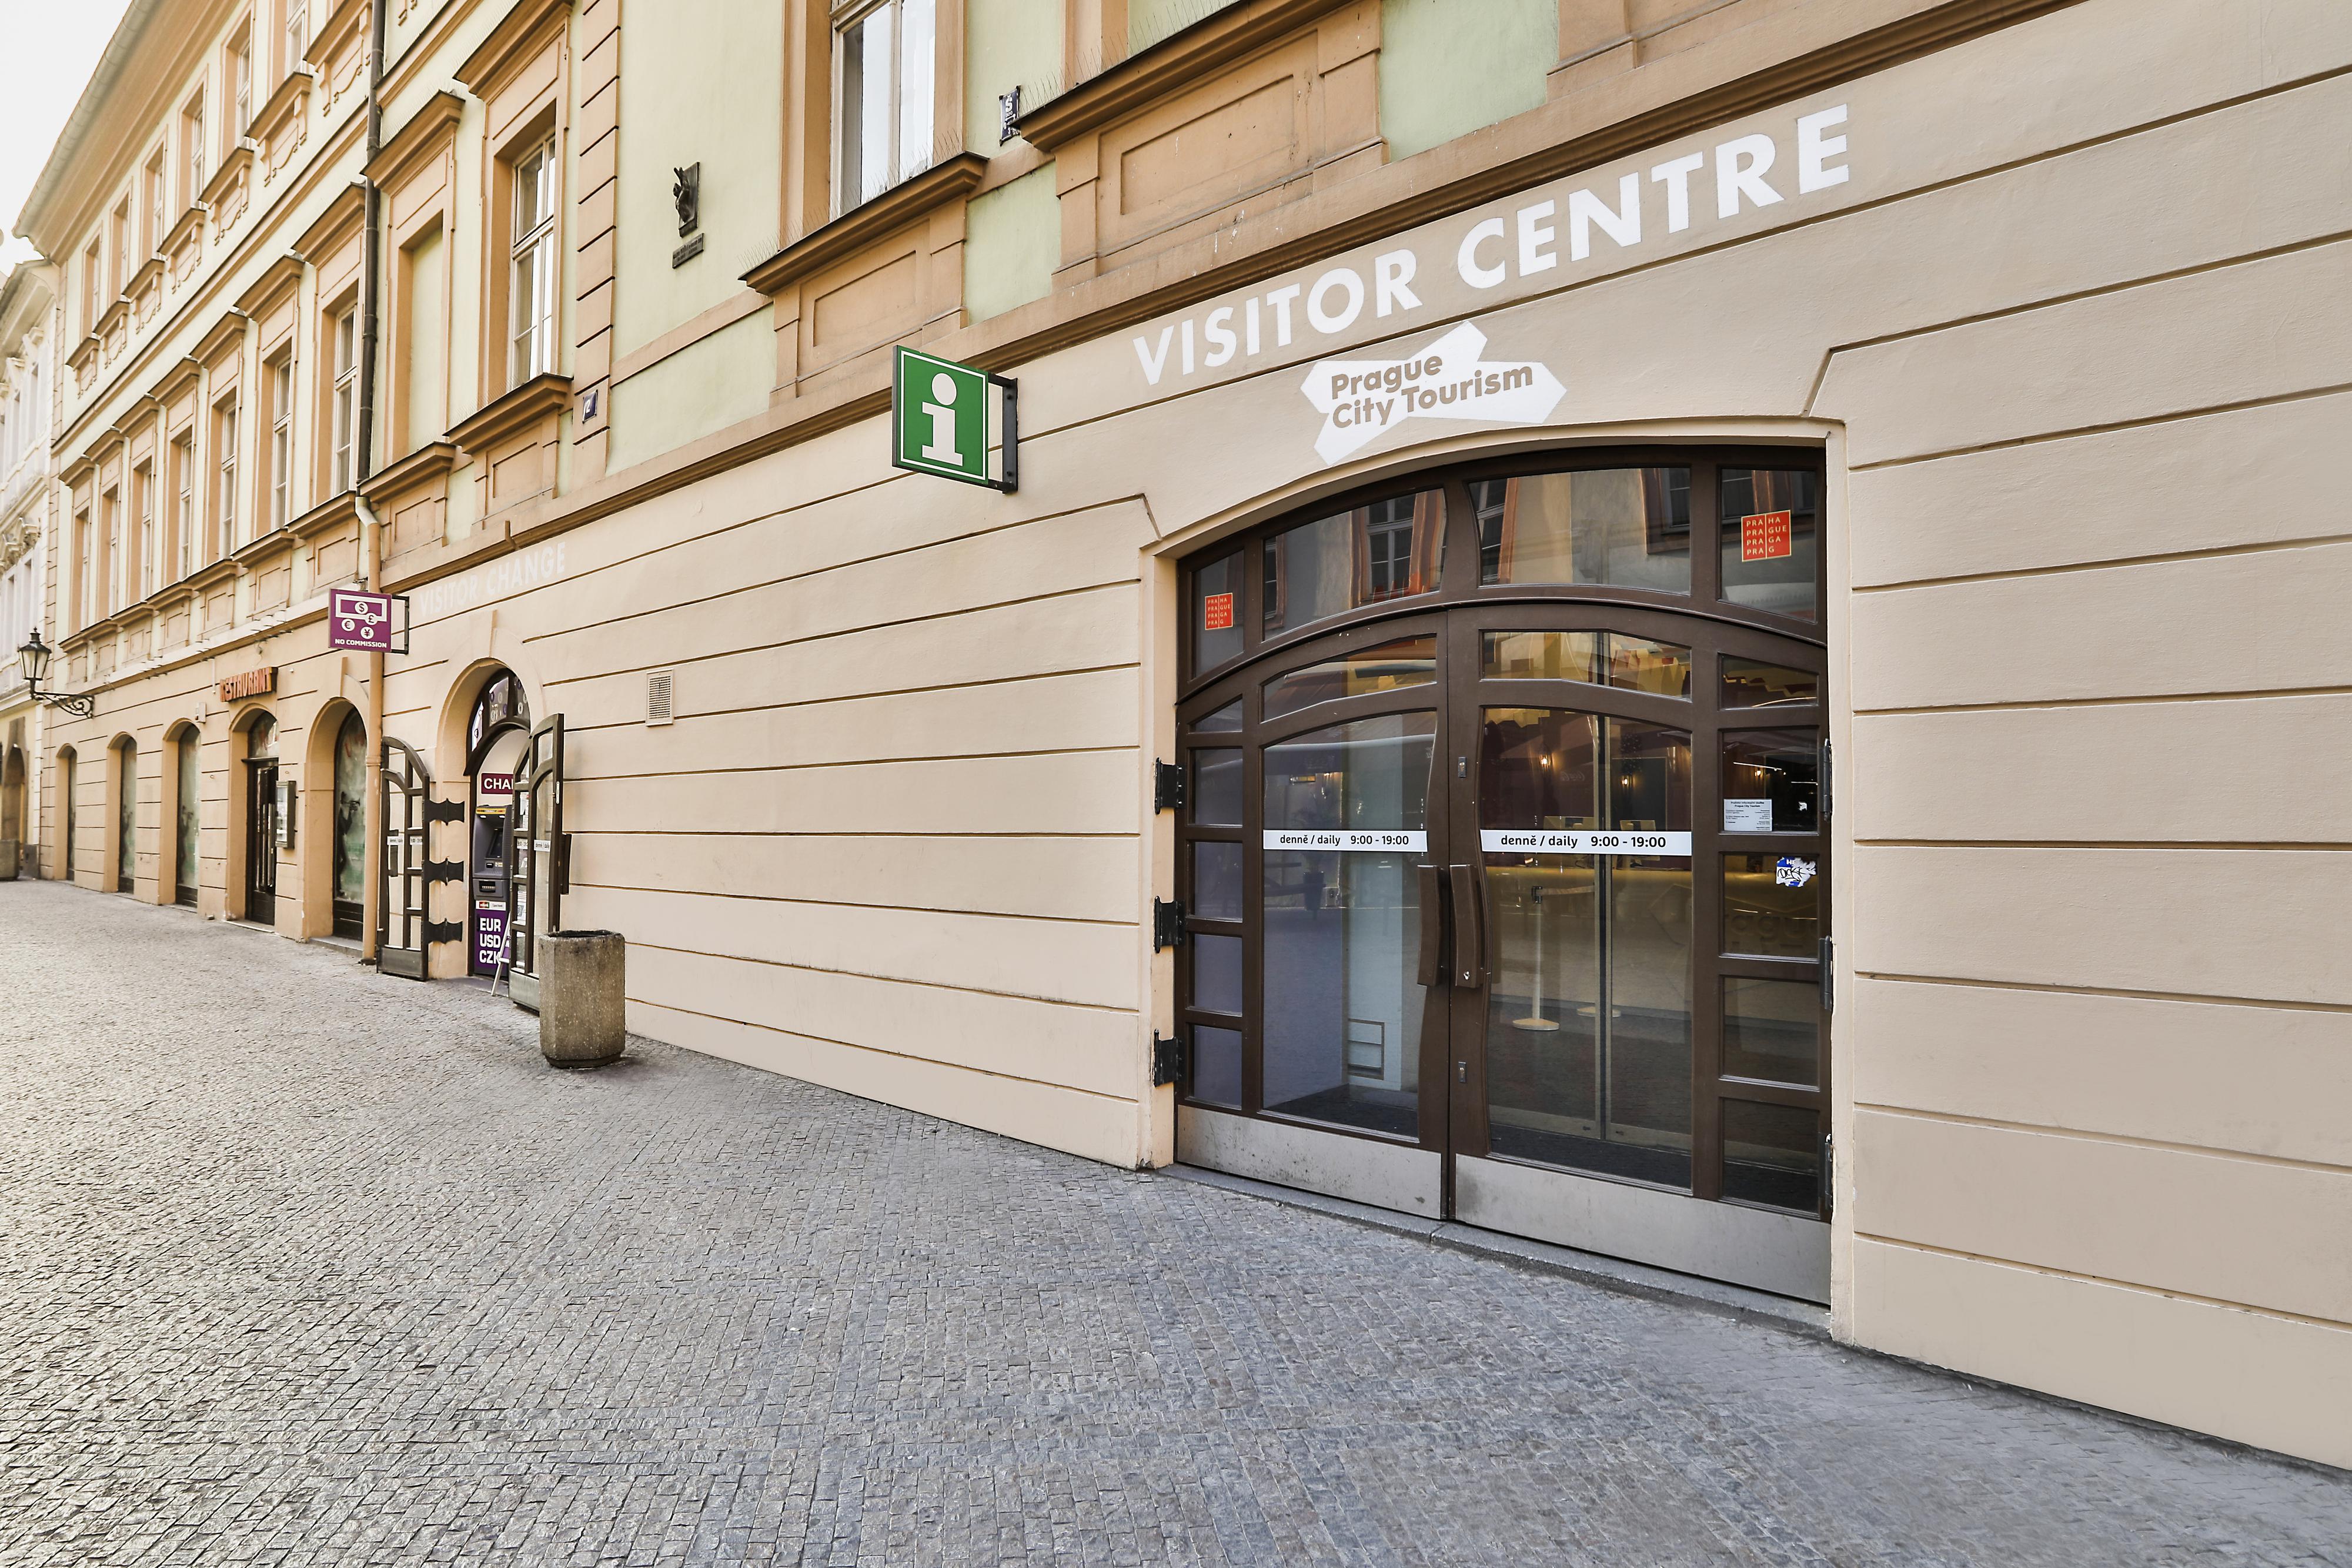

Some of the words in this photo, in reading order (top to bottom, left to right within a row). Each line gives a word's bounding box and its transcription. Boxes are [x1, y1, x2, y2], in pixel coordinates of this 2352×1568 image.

[1132, 248, 1423, 386] VISITOR
[1457, 103, 1850, 289] CENTRE
[1331, 355, 1444, 400] Prague
[1332, 398, 1395, 429] City
[1401, 364, 1534, 413] Tourism
[1768, 525, 1787, 534] GUE
[420, 574, 480, 616] VISITOR
[487, 541, 566, 595] CHANGE
[346, 639, 387, 648] COMMISSION
[484, 778, 513, 790] CHA
[1280, 835, 1308, 844] denně
[1317, 835, 1341, 847] daily
[1351, 835, 1373, 845] 9:00
[1382, 835, 1409, 845] 19:00
[1501, 835, 1537, 846] denně
[1548, 835, 1578, 850] daily
[1591, 836, 1620, 847] 9:00
[1631, 837, 1666, 848] 19:00
[480, 917, 501, 932] EUR
[480, 933, 501, 948] USD
